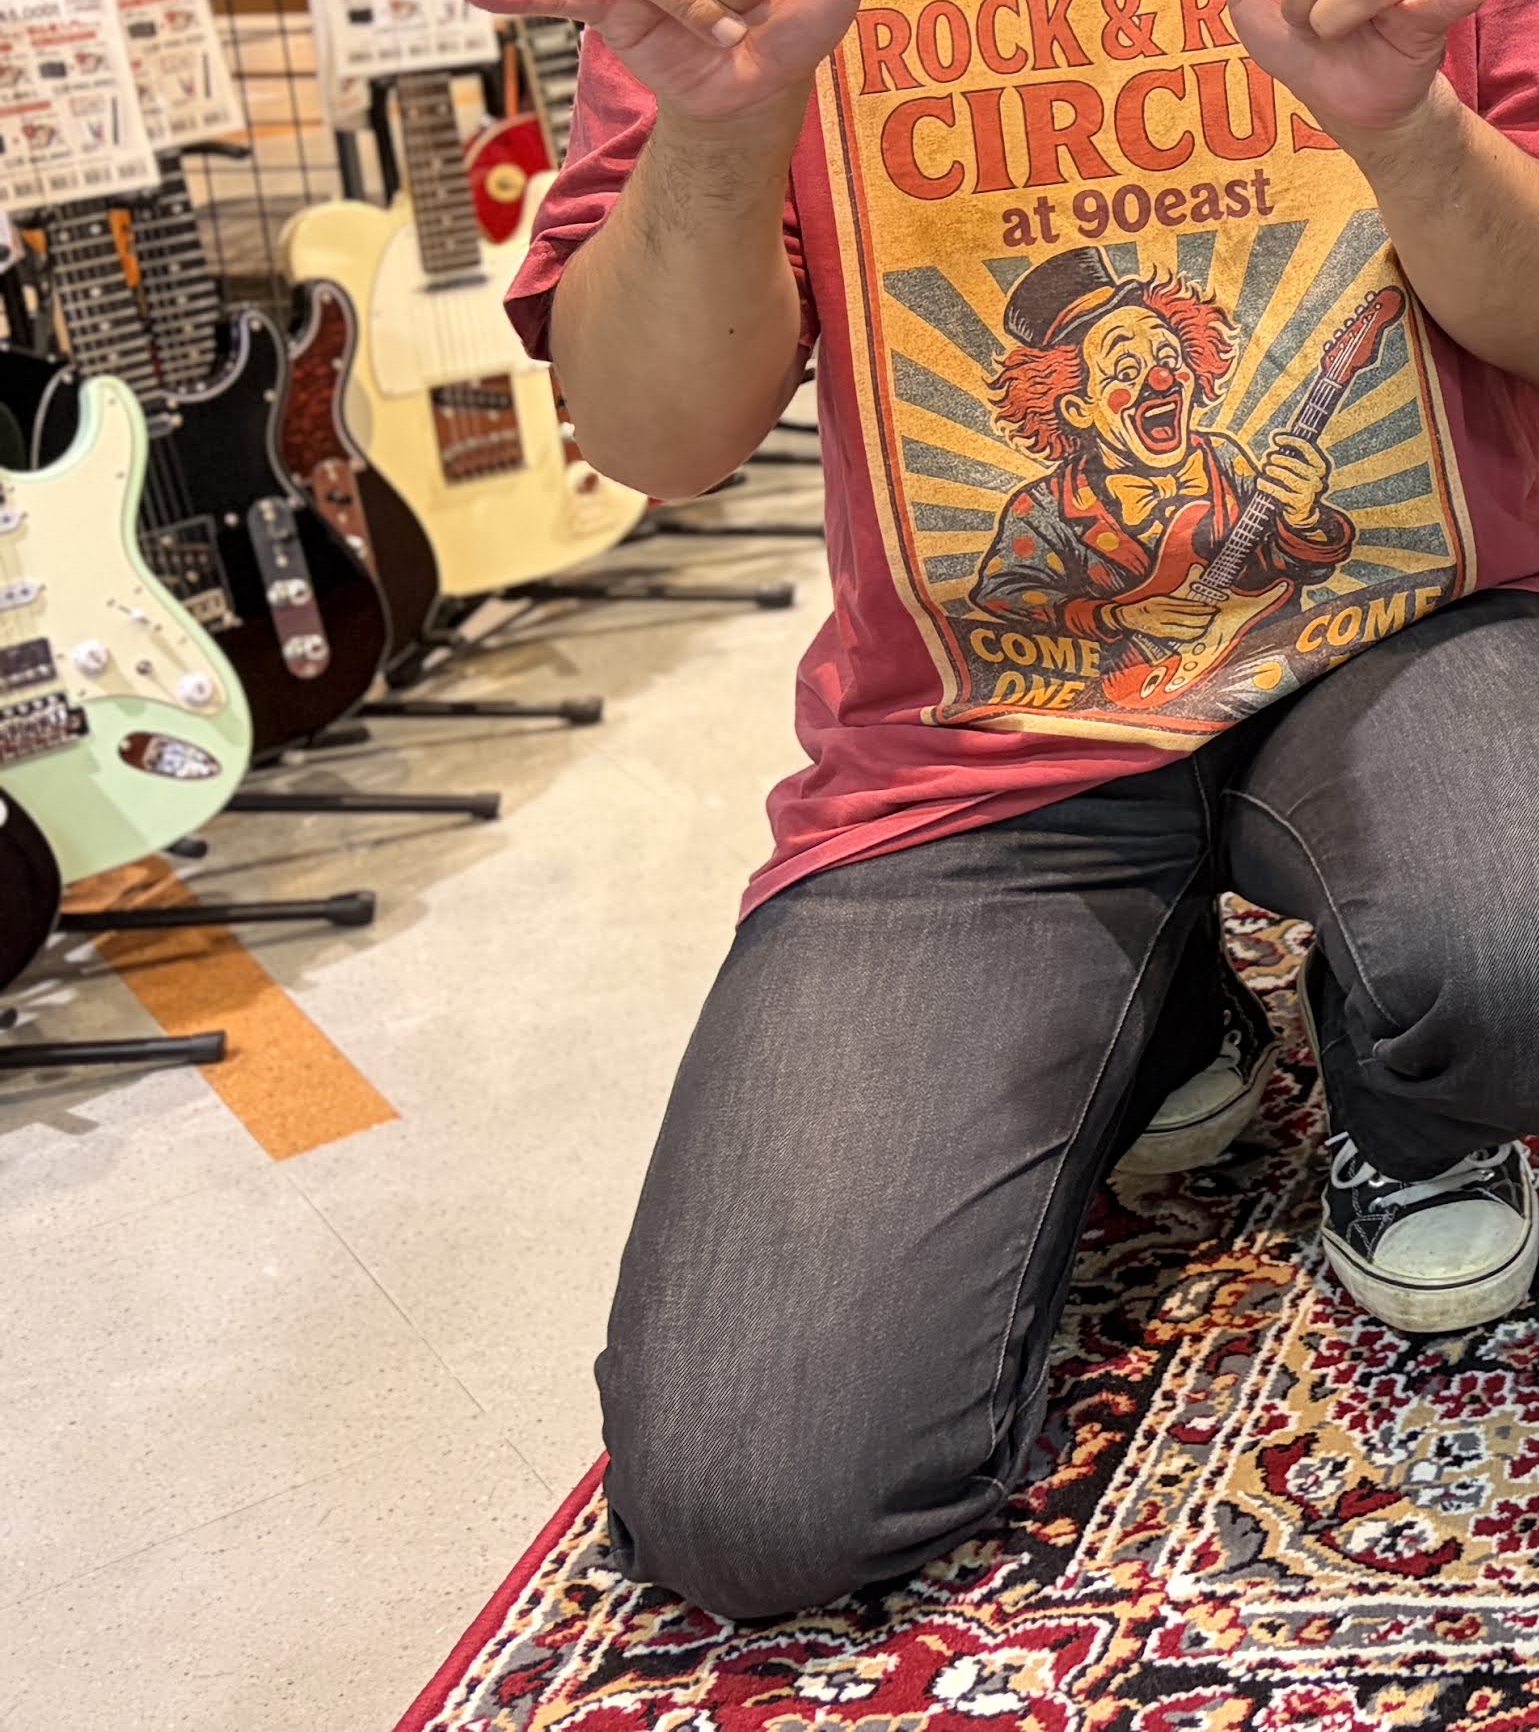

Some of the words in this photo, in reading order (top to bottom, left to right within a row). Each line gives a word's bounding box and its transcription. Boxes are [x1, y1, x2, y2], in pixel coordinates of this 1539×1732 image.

[880, 57, 1343, 201] CIRCU
[1003, 194, 1061, 248] at
[1072, 169, 1275, 239] 90east
[970, 628, 1101, 677] COME
[988, 671, 1086, 709] ONE
